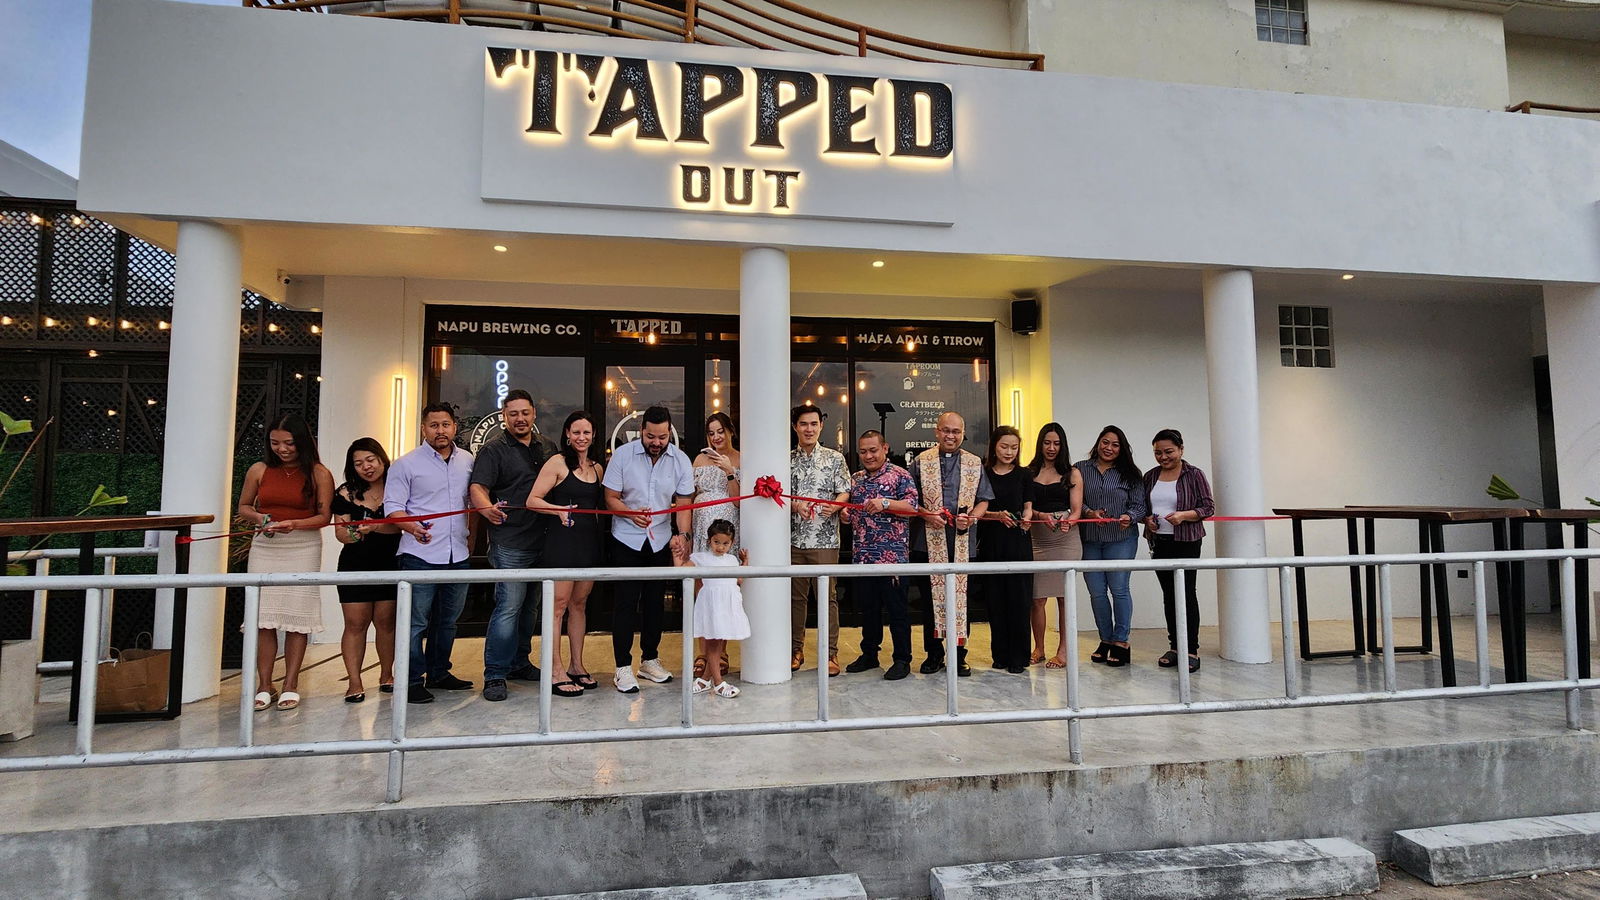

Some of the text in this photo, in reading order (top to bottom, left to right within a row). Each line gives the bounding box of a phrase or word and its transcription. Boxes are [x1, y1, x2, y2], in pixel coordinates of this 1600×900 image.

[486, 46, 954, 158] TAPPED
[681, 164, 801, 208] OUT
[438, 321, 580, 335] NAPU BREWING CO.
[610, 319, 682, 334] TAPPED
[933, 335, 940, 345] &
[943, 336, 984, 346] TIROW
[900, 401, 945, 409] CRAFTBEER
[474, 417, 495, 442] NAPU
